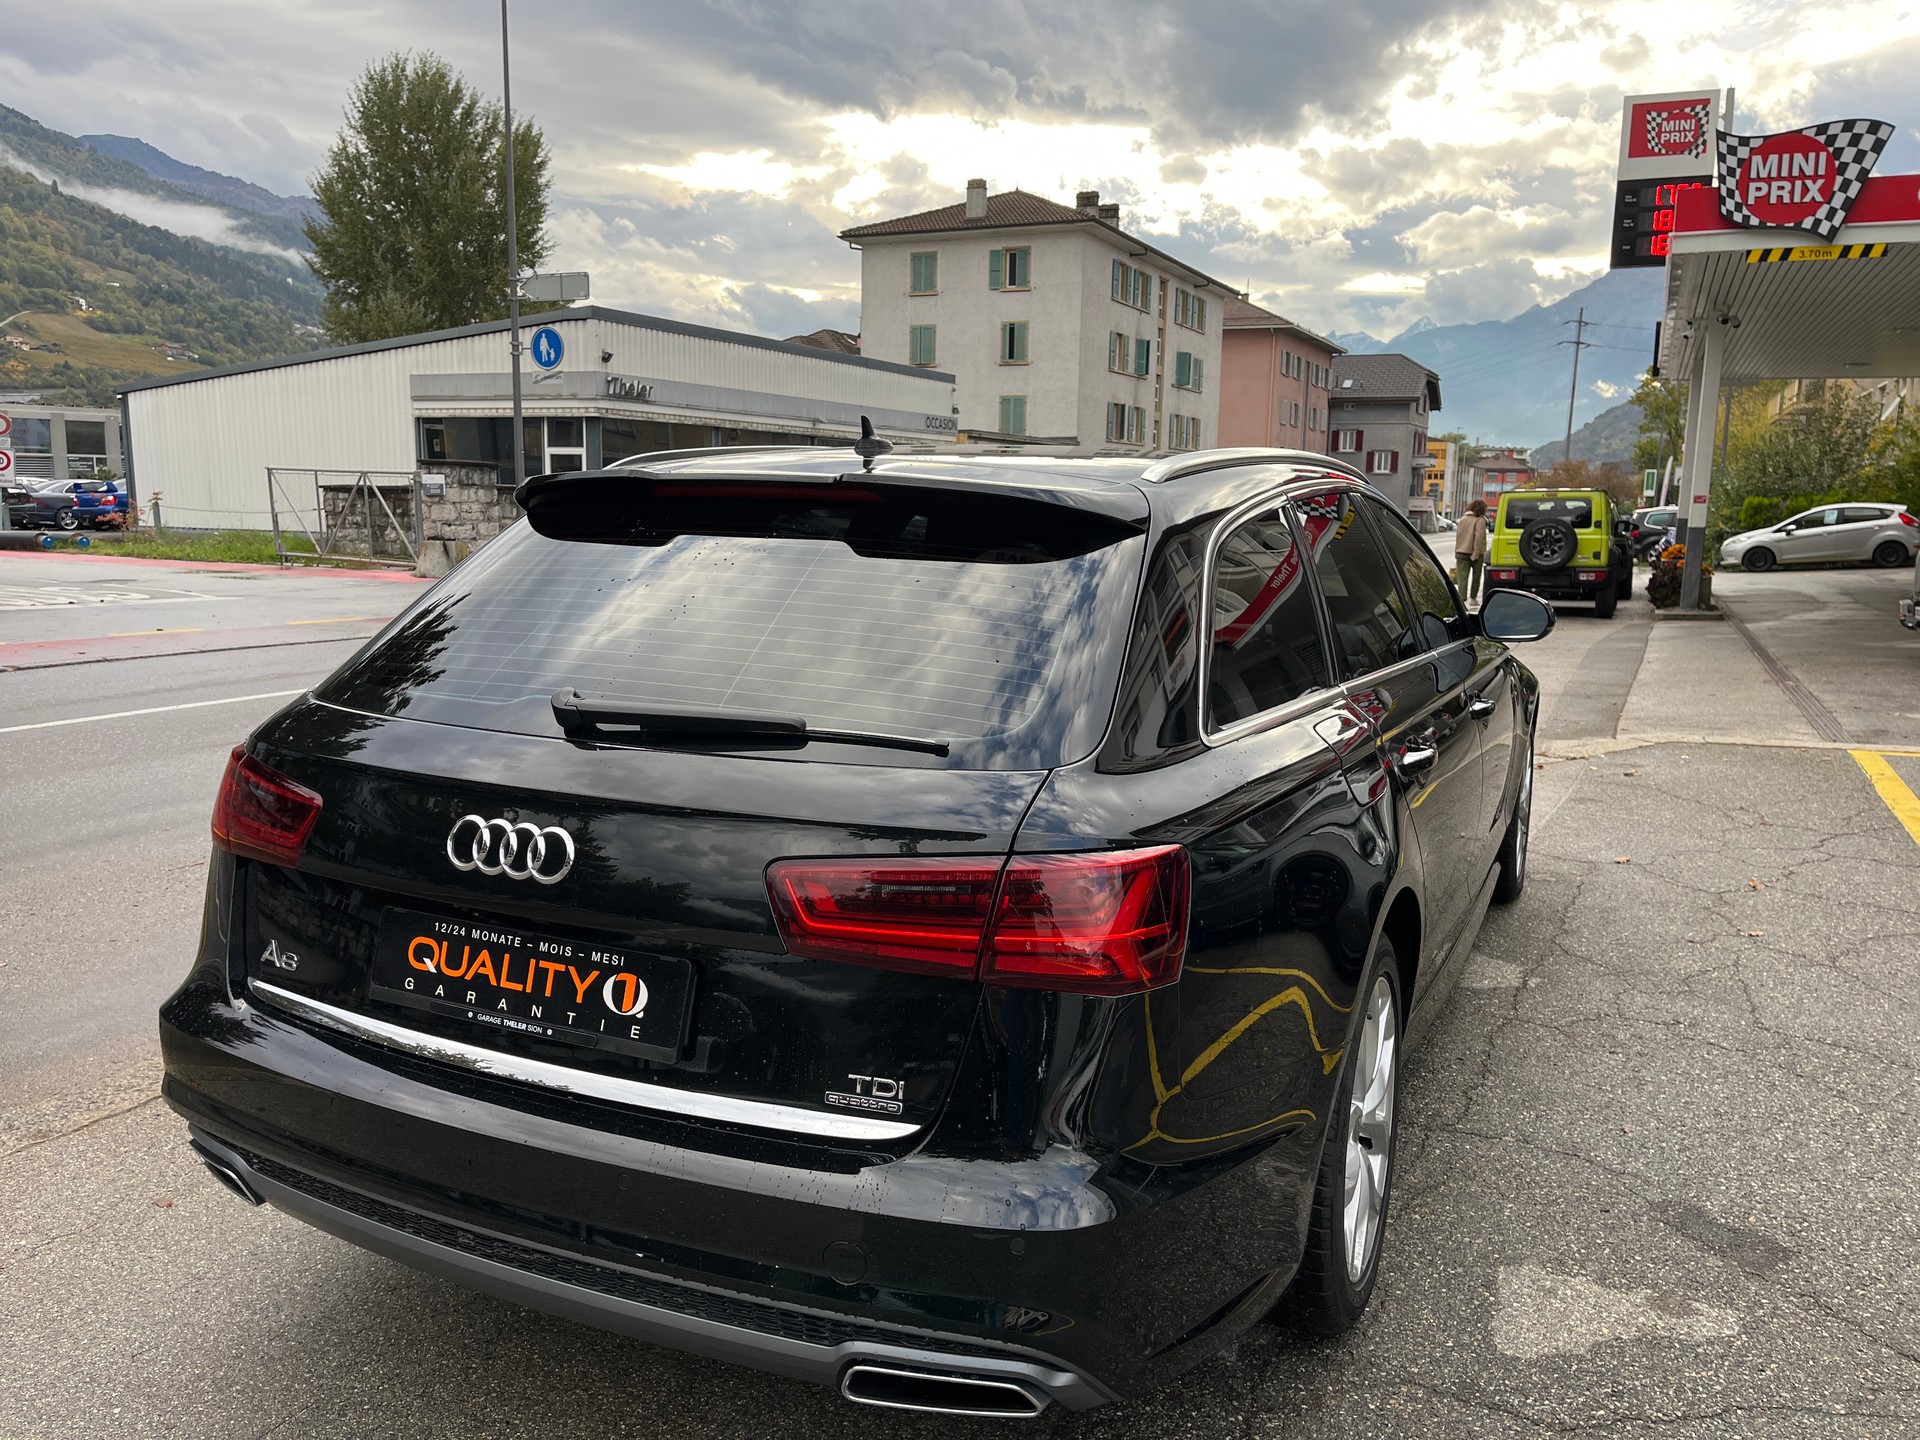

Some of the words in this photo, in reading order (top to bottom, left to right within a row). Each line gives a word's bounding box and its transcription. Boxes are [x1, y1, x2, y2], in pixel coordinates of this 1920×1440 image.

[1660, 131, 1695, 144] PRIX
[1662, 119, 1696, 132] MINI
[1750, 151, 1827, 179] MINI
[1747, 178, 1826, 206] PRIX
[1798, 250, 1833, 259] 3.70m
[606, 376, 653, 398] Theler
[260, 939, 301, 971] A6
[435, 922, 466, 937] 12/24
[471, 929, 521, 948] MONATE
[539, 941, 572, 957] MOIS
[591, 951, 625, 967] MESI
[407, 936, 601, 1004] QUALITY
[404, 977, 641, 1039] GARANTIE
[477, 1013, 502, 1025] GARAGE
[503, 1019, 527, 1030] THELER
[527, 1024, 543, 1034] SION
[847, 1073, 905, 1100] TDI
[827, 1094, 899, 1112] quattro
